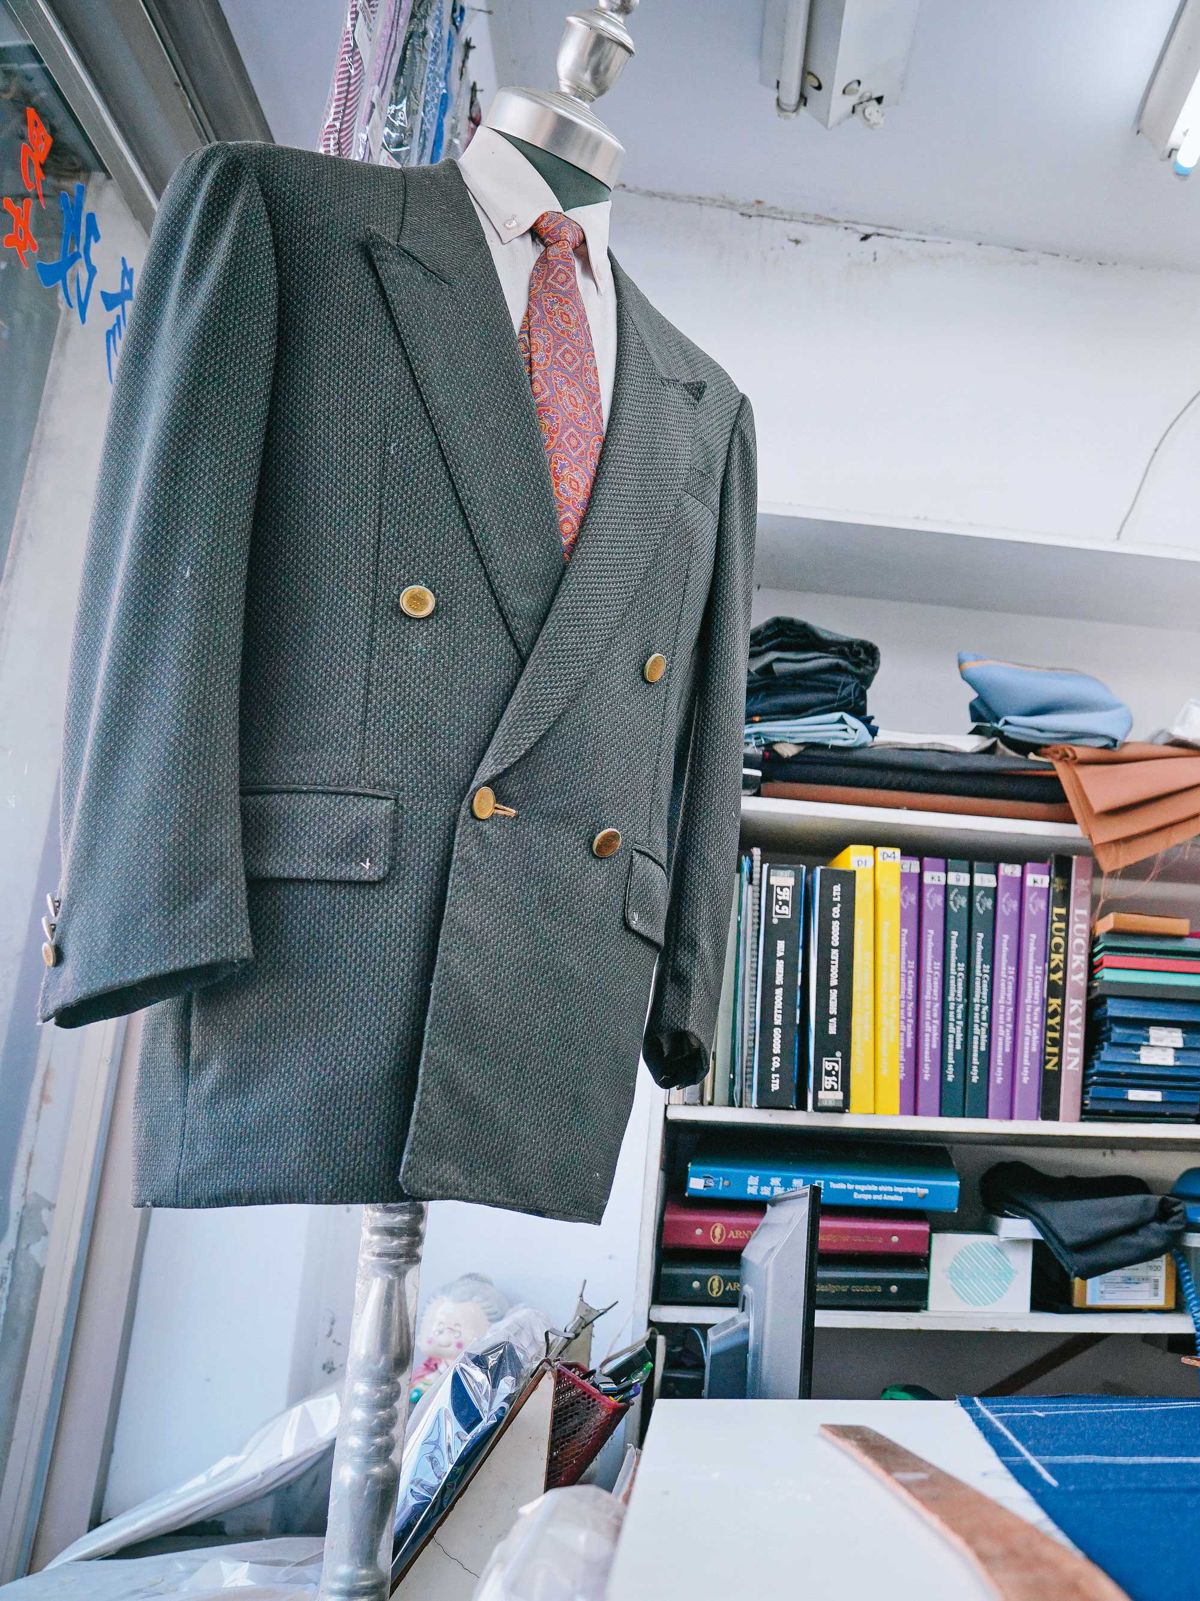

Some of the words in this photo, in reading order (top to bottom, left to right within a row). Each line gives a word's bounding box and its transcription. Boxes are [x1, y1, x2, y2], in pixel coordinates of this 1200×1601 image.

[1050, 906, 1067, 986] LUCKY
[1070, 908, 1088, 986] LUCKY
[773, 1028, 781, 1053] GOODS
[1044, 998, 1062, 1071] KYLIN
[1066, 999, 1082, 1072] KYLIN
[726, 1282, 740, 1292] AR
